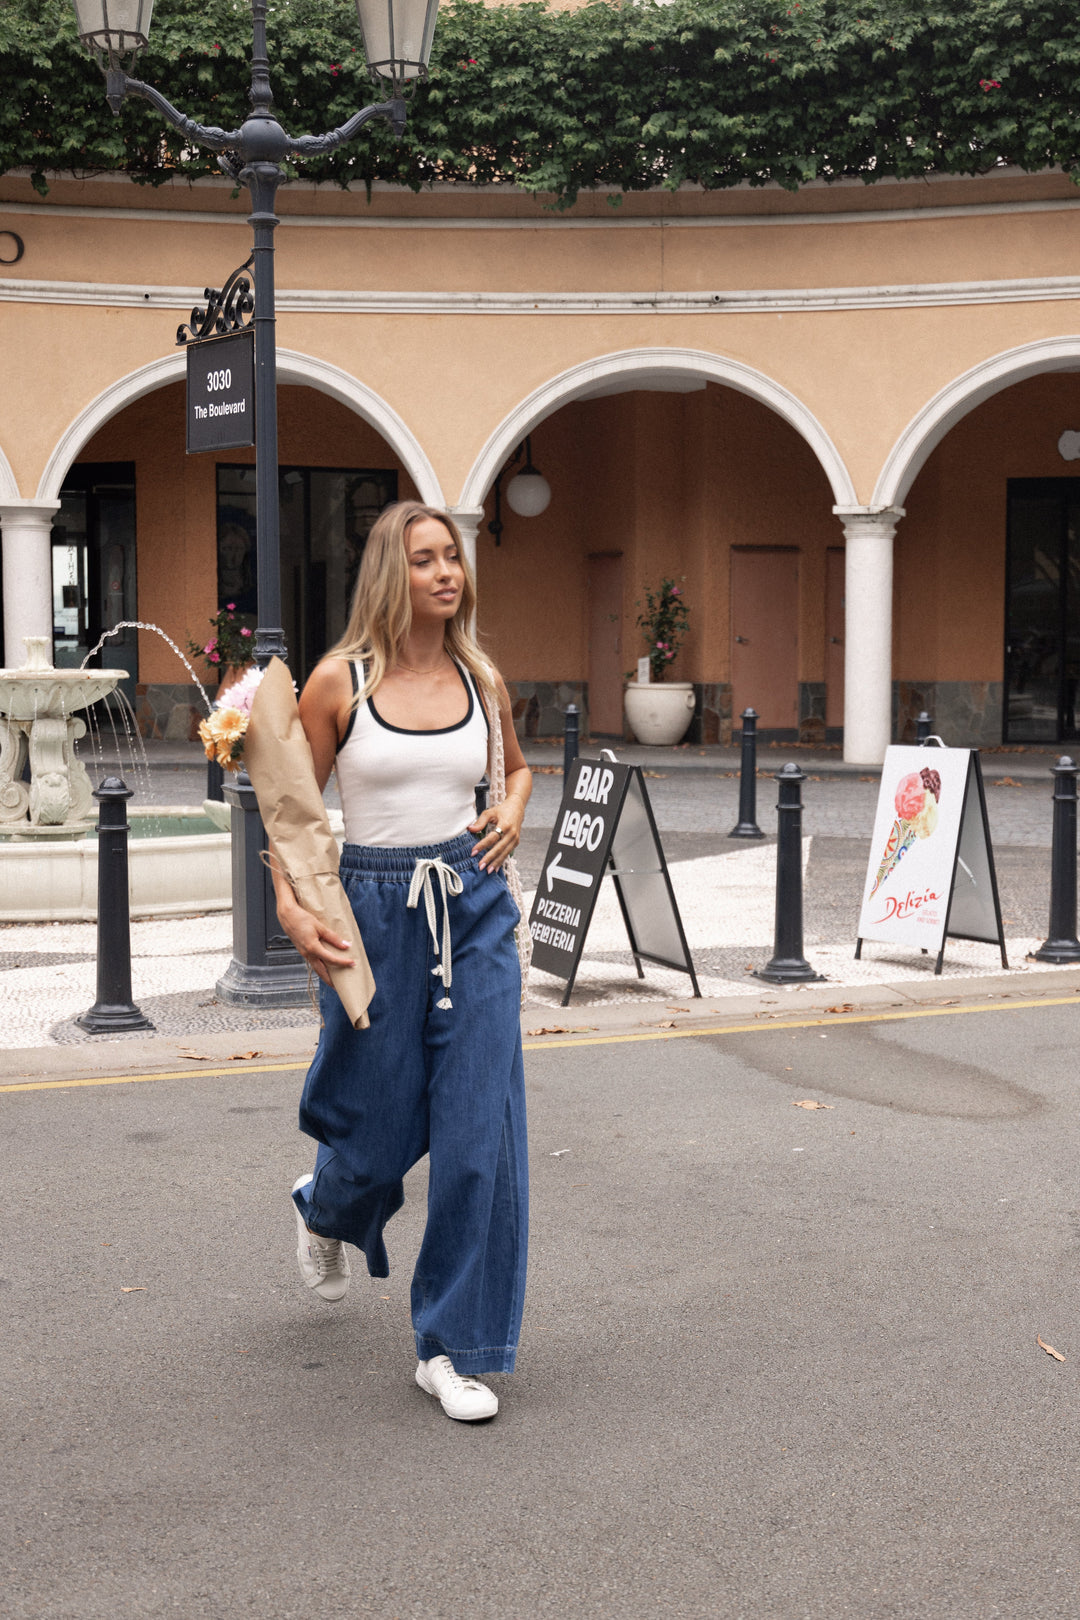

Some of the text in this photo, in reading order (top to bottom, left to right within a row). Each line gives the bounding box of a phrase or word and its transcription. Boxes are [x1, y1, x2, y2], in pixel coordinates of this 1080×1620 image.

[207, 368, 232, 392] 3030
[194, 398, 246, 419] The Boulevard
[573, 765, 614, 805] BAR
[557, 809, 605, 852] LAGO
[536, 897, 581, 928] PIZZERIA
[870, 888, 944, 924] Delizia
[530, 921, 576, 953] GELATERIA
